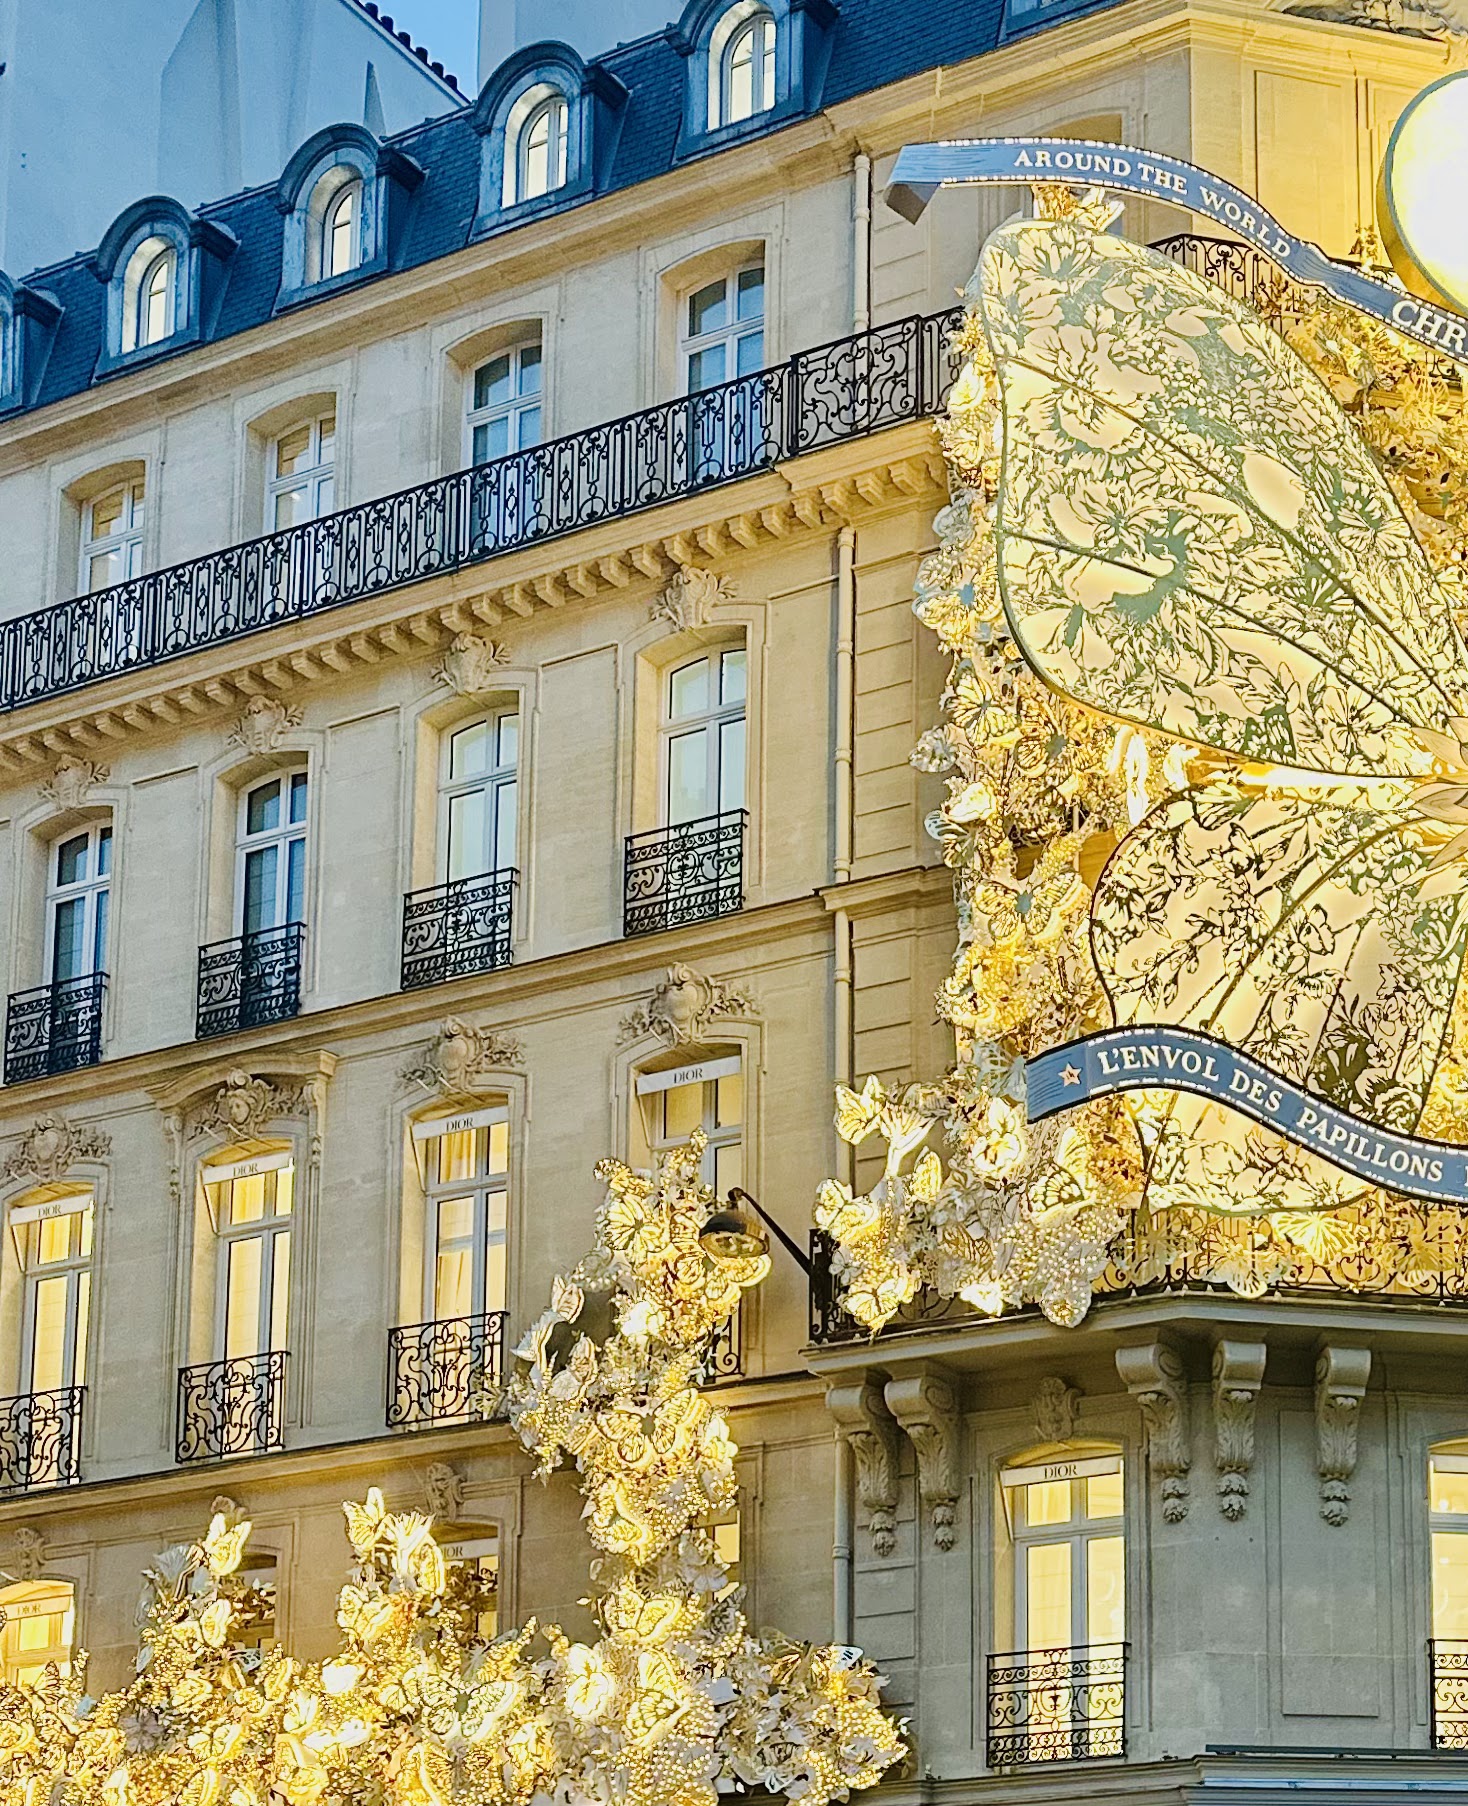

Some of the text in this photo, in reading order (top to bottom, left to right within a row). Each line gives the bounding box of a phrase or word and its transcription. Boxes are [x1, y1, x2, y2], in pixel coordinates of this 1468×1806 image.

[1013, 149, 1293, 260] AROUND THE WORLD
[673, 1067, 703, 1084] DIOR
[1097, 1044, 1219, 1082] L'ENVOL
[1229, 1068, 1283, 1112] DES
[1296, 1106, 1445, 1182] PAPILLONS
[445, 1117, 474, 1132] DIOR
[232, 1162, 258, 1176] DIOR
[37, 1203, 62, 1218] DIOR
[1044, 1464, 1078, 1480] DIOR
